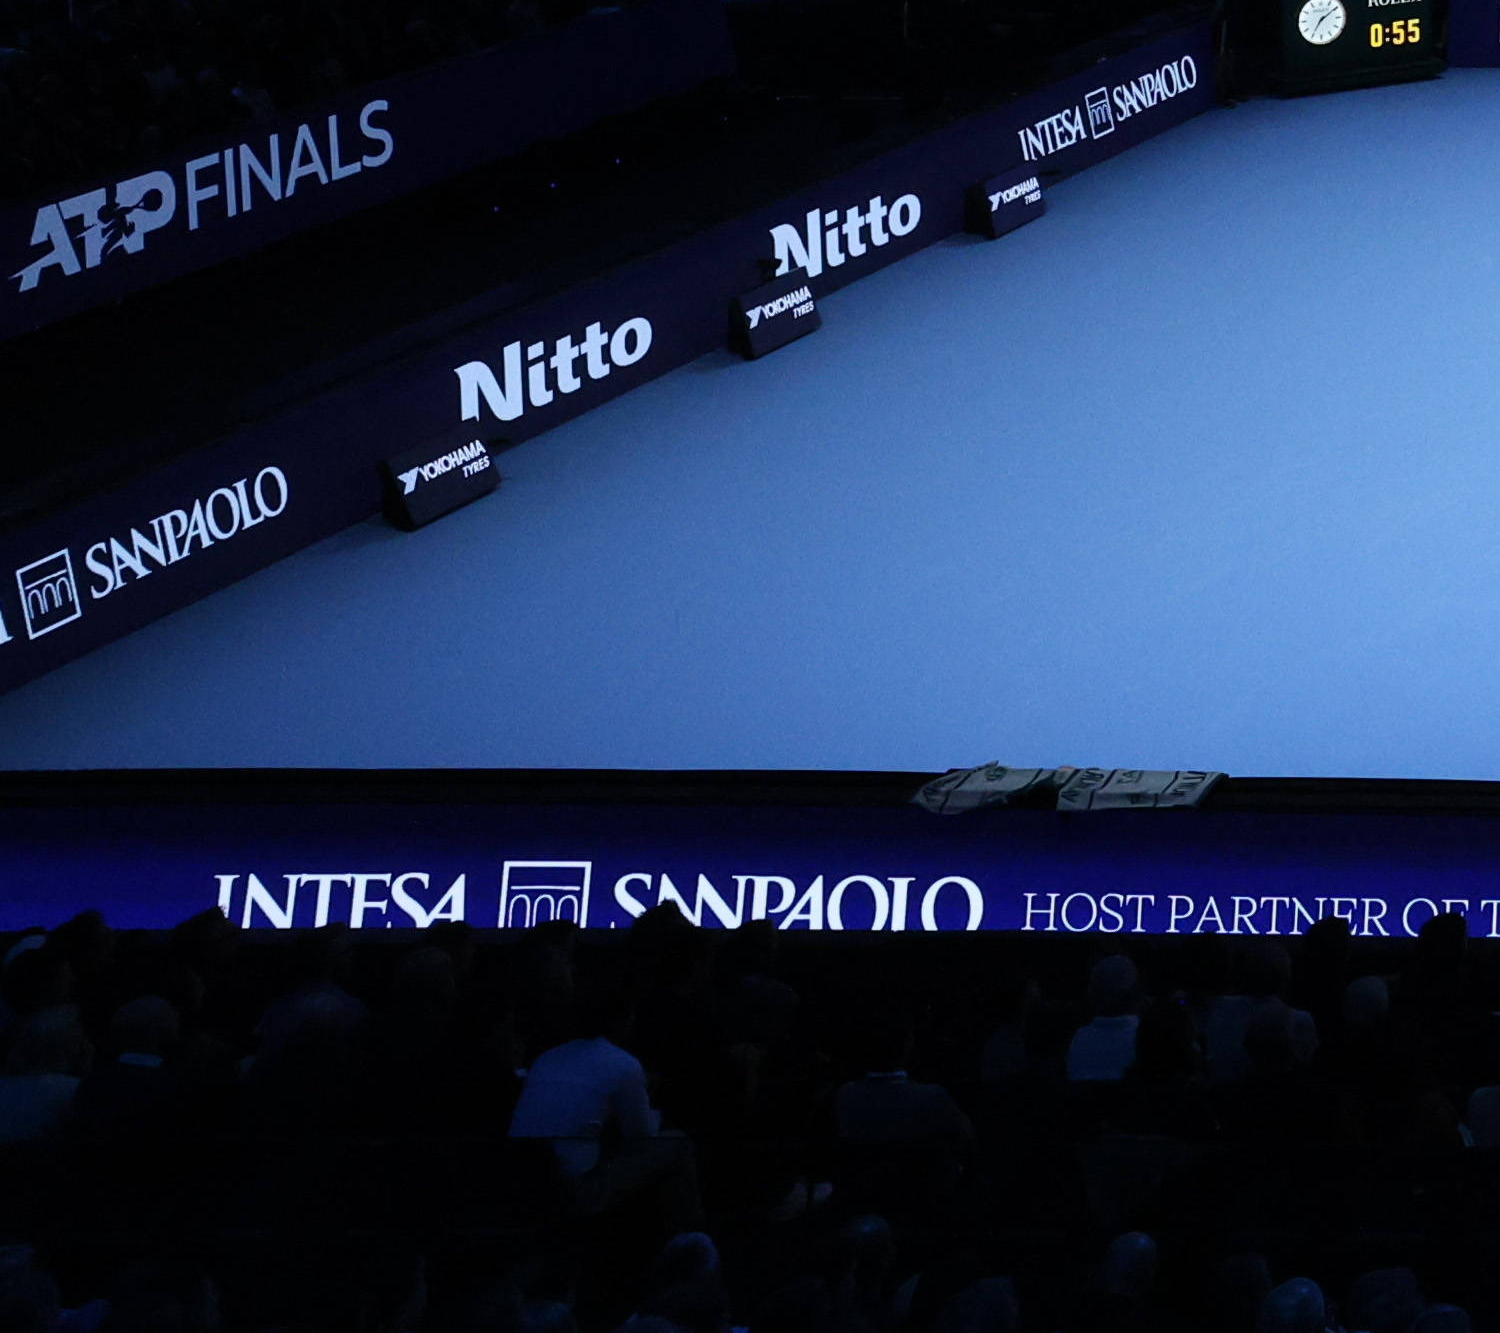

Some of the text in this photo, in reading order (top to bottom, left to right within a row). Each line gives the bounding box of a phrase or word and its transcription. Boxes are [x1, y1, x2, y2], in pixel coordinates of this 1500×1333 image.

[1370, 17, 1422, 48] 0:55
[1017, 55, 1197, 161] INTESA SANPAOLO
[8, 99, 395, 293] ATP FINALS
[1001, 176, 1040, 205] YOKOHAMA
[769, 193, 922, 279] Nitto
[761, 285, 813, 320] YOKOHAMA
[793, 300, 816, 320] TYRES
[454, 316, 653, 422] Nitto
[418, 438, 487, 482] YOKOHAMA
[461, 455, 491, 479] TYRES
[84, 465, 289, 600] SANPAOLO
[213, 872, 985, 933] INTESA SANPAOLO
[1021, 892, 1156, 933] HOST
[1165, 895, 1390, 937] PARTNER
